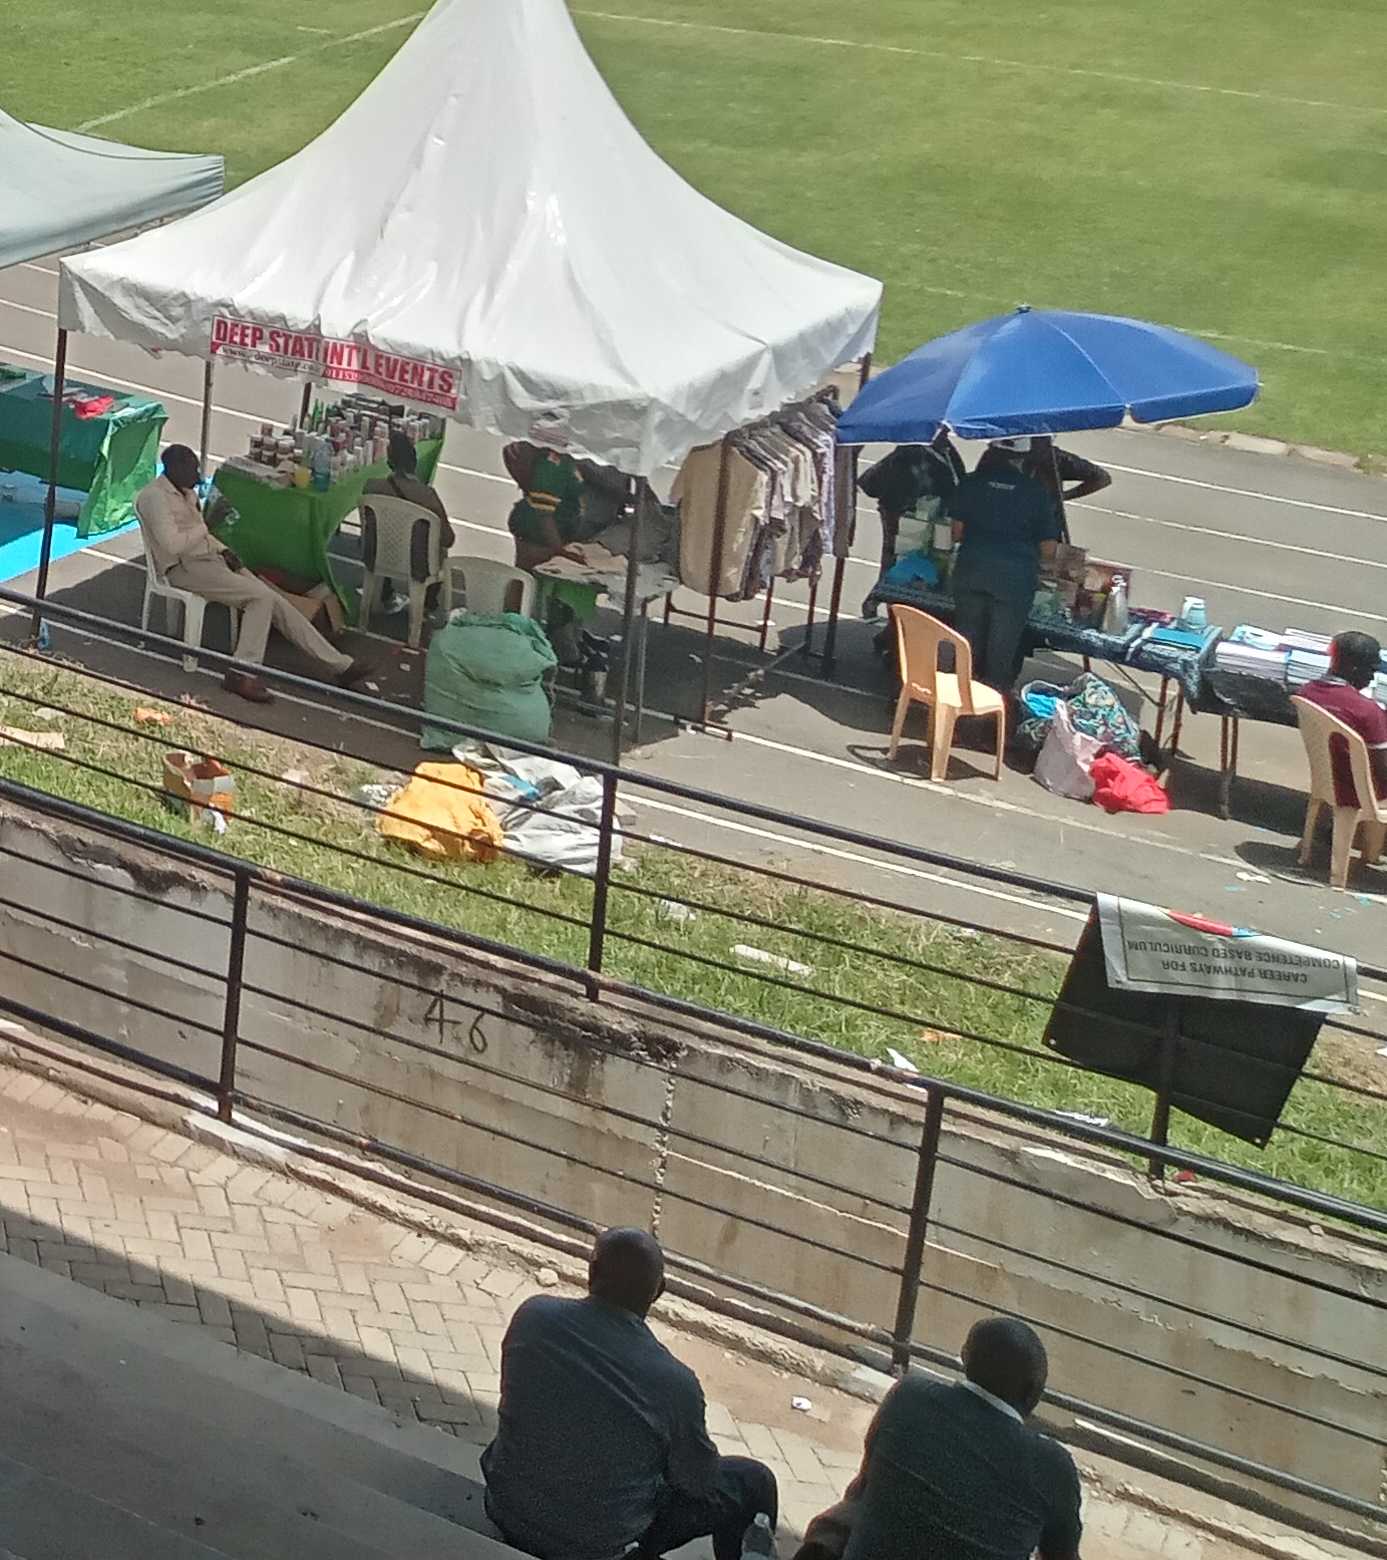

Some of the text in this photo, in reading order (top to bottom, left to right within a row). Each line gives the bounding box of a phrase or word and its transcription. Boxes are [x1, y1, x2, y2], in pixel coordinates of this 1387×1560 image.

[215, 319, 264, 349] DEEP
[268, 328, 322, 362] STAT
[374, 355, 455, 393] EVENTS
[1127, 940, 1340, 970] COMPETENCE BASED CURRICULUM
[1162, 959, 1308, 984] CAREER PATHWAYS FOR
